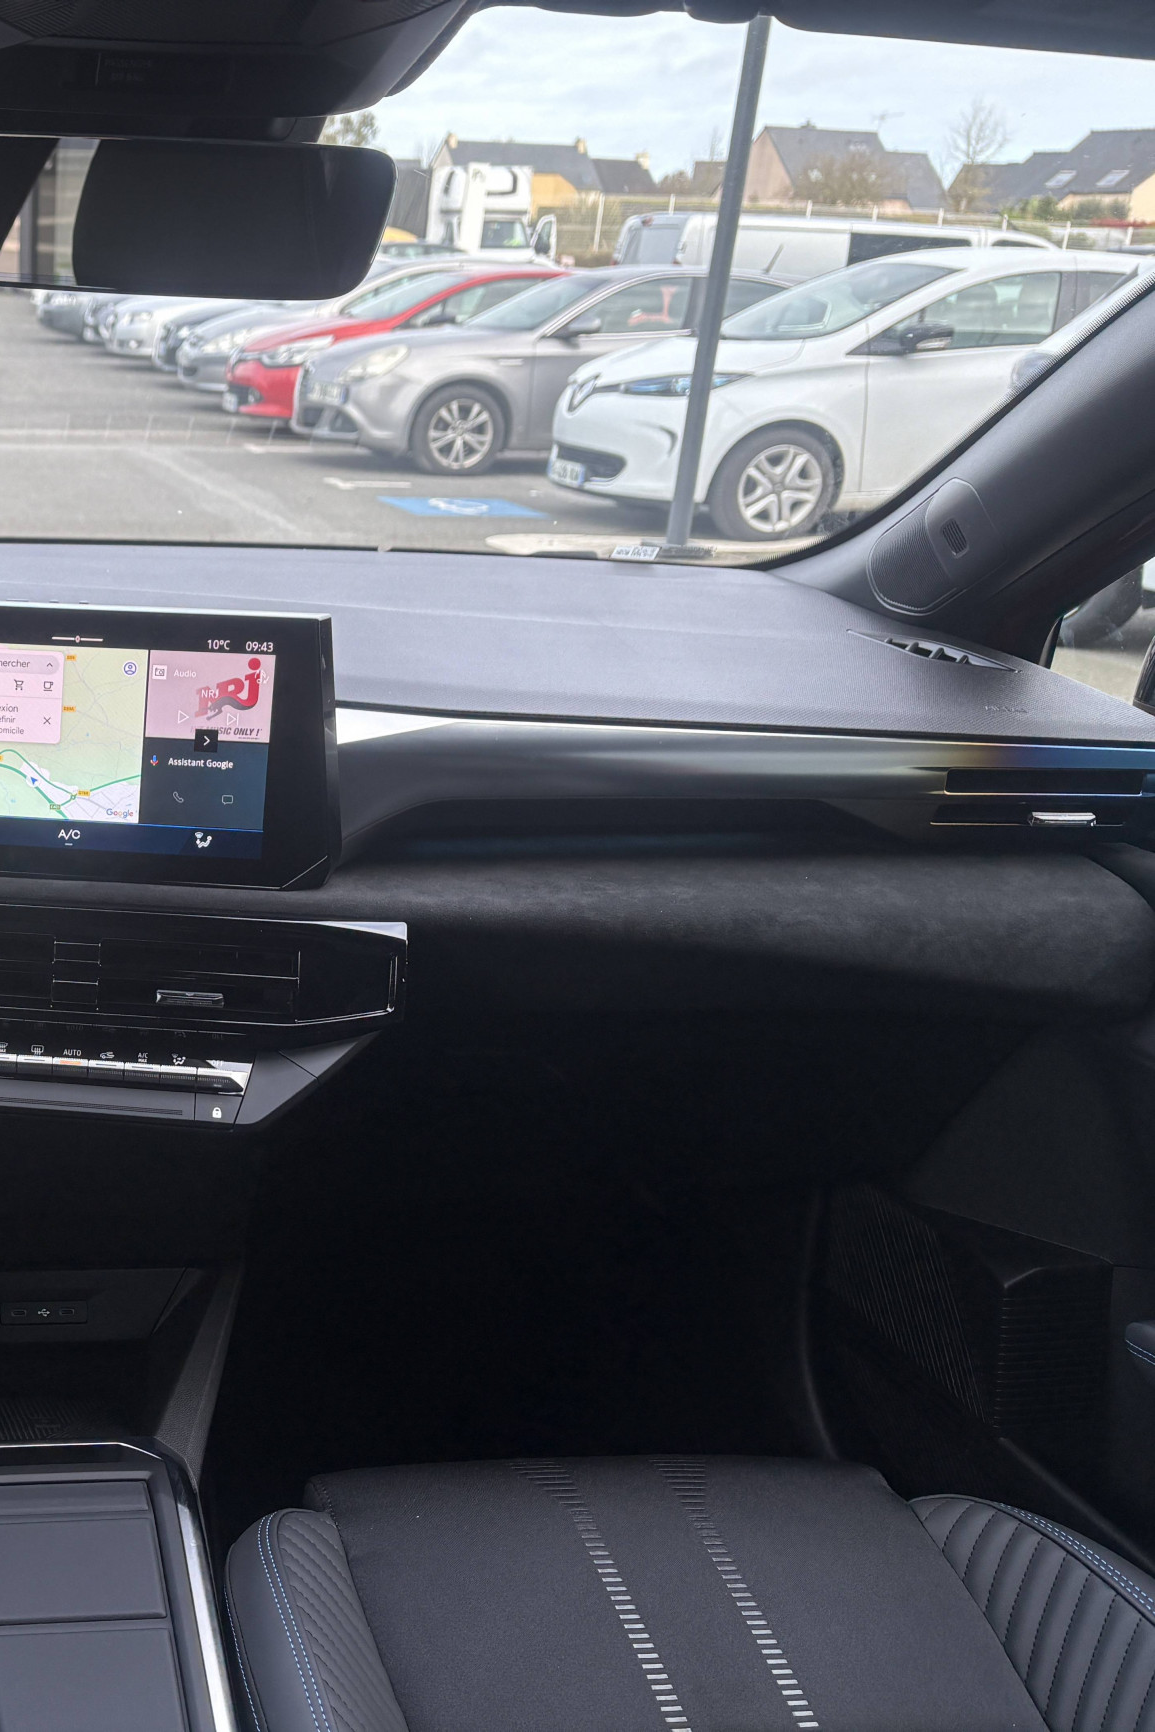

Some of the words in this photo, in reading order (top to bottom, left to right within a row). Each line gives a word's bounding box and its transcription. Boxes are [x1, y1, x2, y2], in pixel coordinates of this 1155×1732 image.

[207, 639, 231, 650] 10°C
[246, 641, 274, 652] 09:43
[173, 669, 197, 678] Audio
[233, 727, 255, 736] ONLY
[168, 757, 205, 767] Assistant
[206, 759, 234, 770] Google
[106, 808, 134, 819] Google
[58, 828, 81, 840] A/C
[62, 1048, 82, 1056] AUTO
